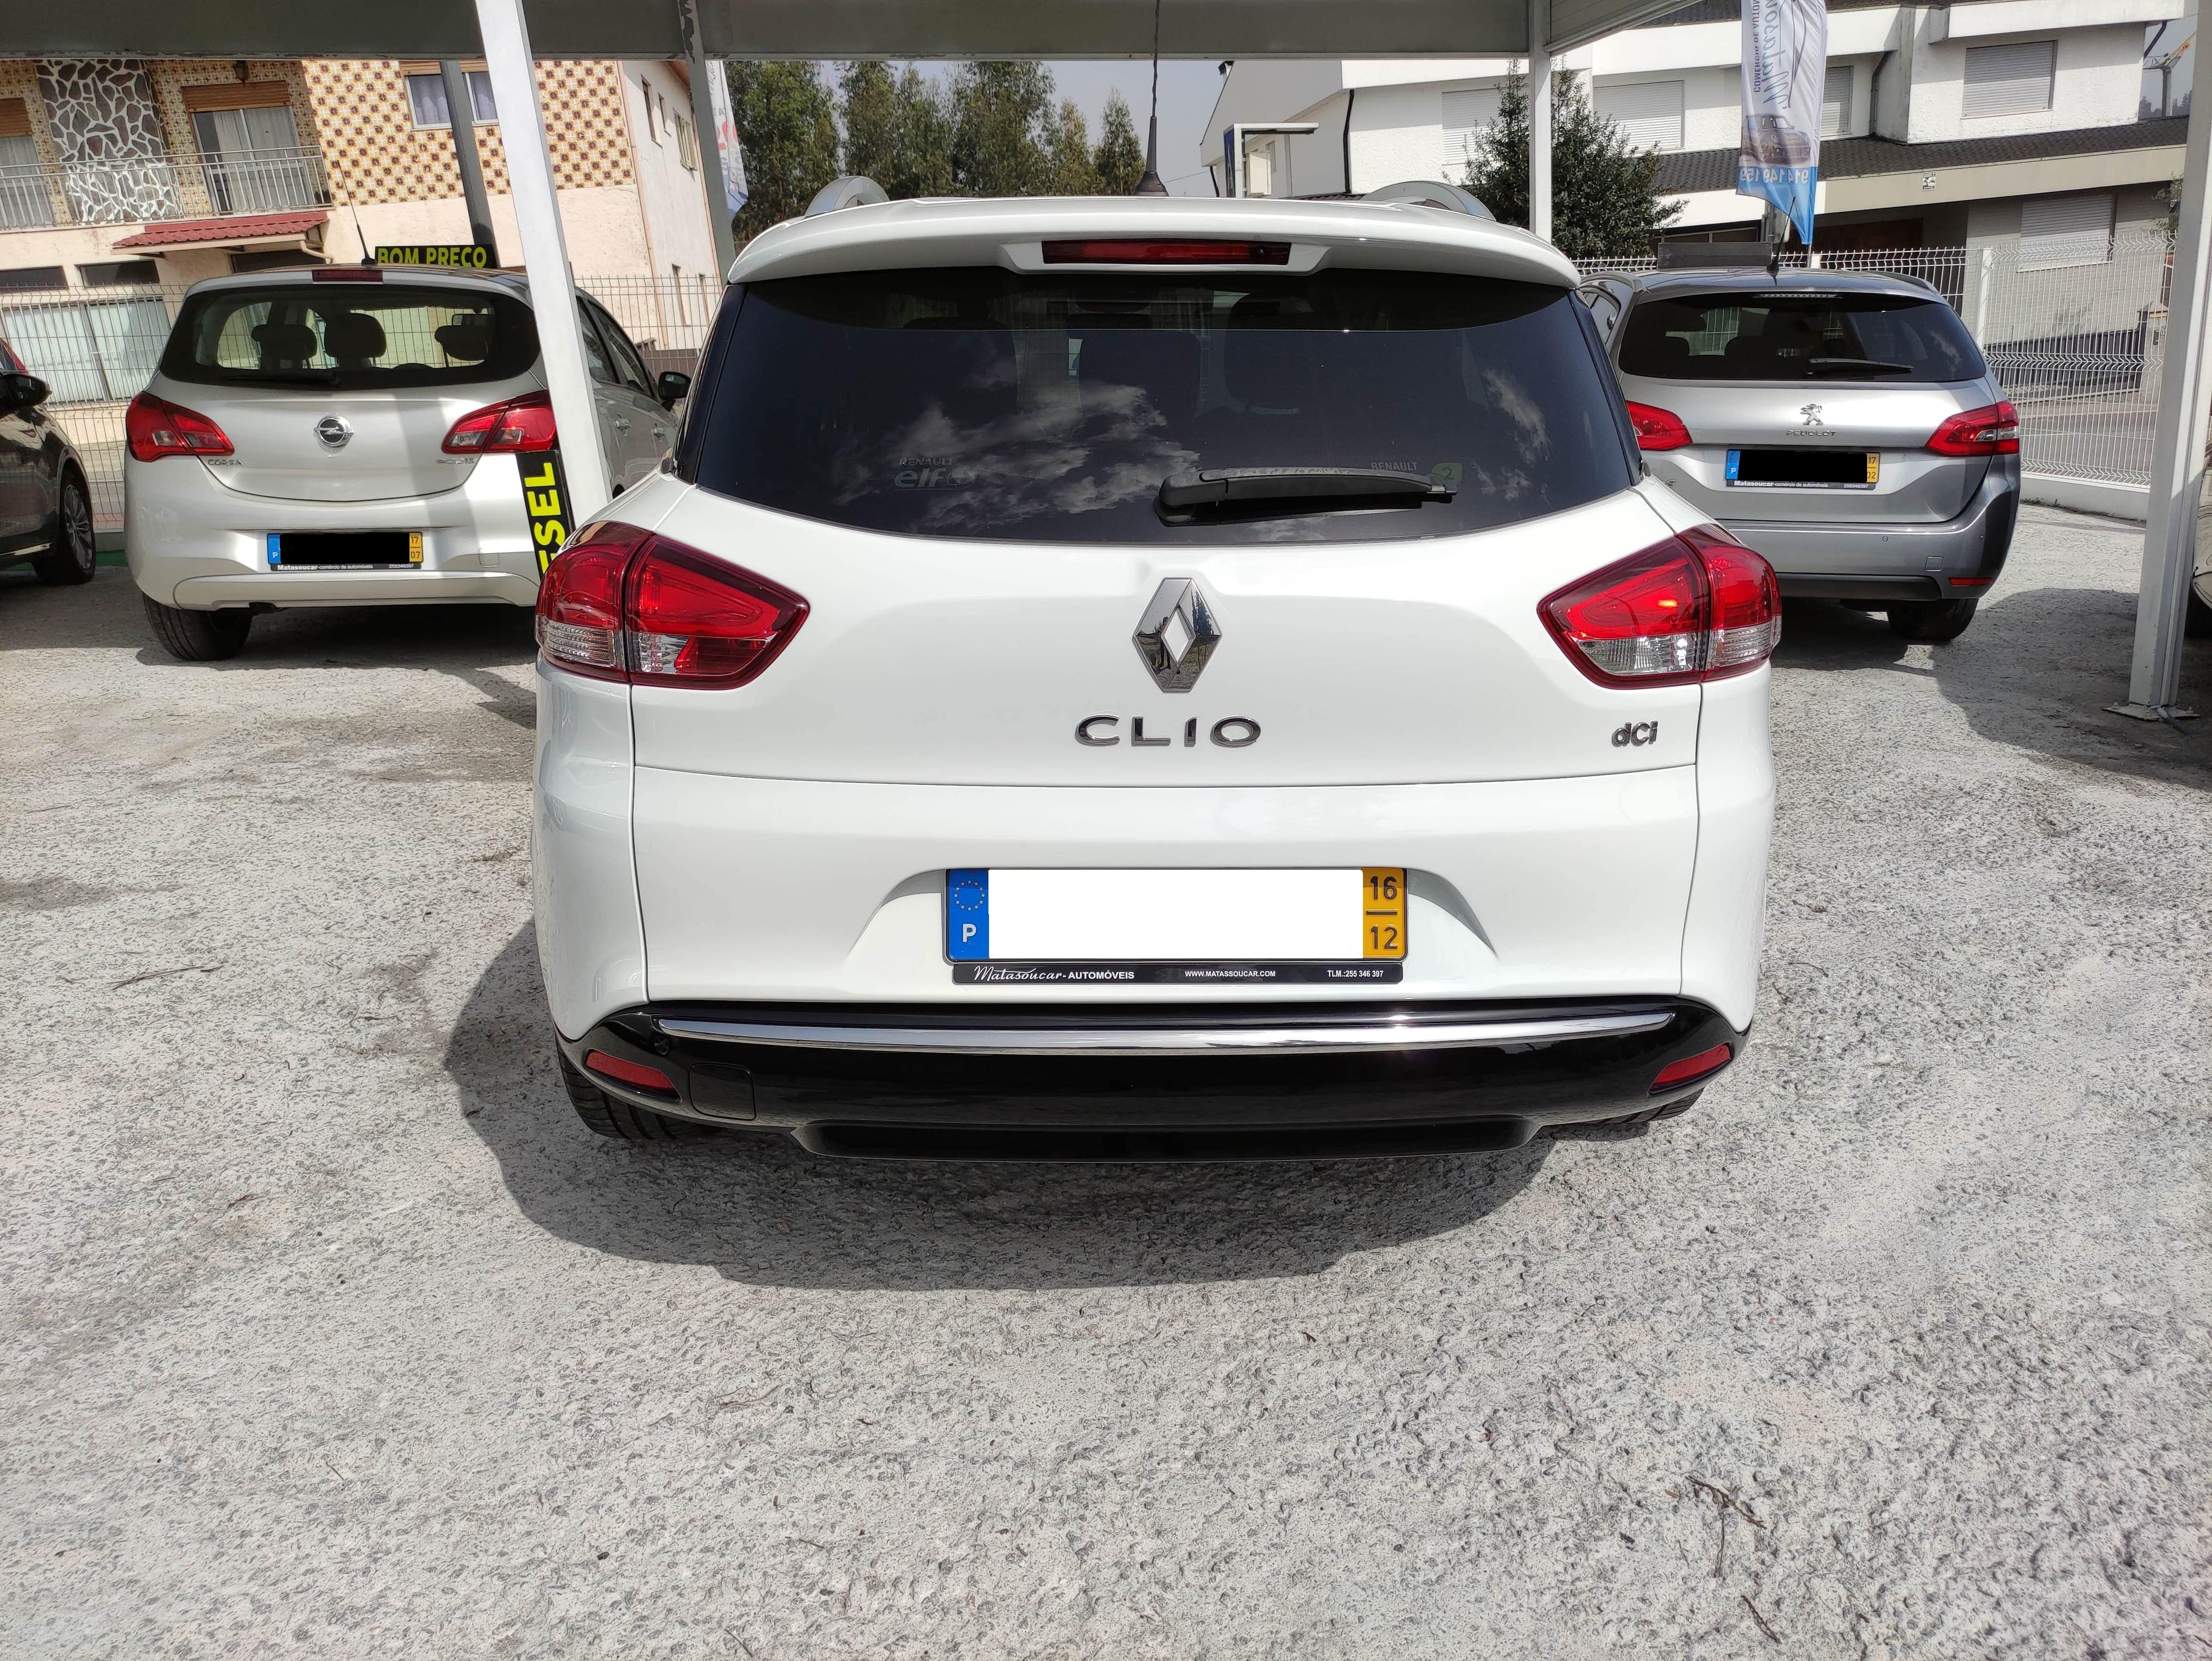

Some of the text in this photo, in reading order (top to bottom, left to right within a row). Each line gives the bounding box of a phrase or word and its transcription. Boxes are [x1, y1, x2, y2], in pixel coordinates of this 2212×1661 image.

[378, 248, 419, 264] BOM
[899, 458, 955, 466] RENAULT
[1371, 461, 1418, 471] RENAULT
[894, 468, 946, 488] elf
[1442, 467, 1454, 480] 2
[411, 536, 419, 545] 17
[411, 551, 420, 559] 07
[1075, 714, 1261, 747] CLIO
[1611, 720, 1658, 747] dCi
[1370, 876, 1397, 900] 16
[962, 923, 977, 943] P
[1371, 926, 1398, 949] 12
[1068, 970, 1135, 980] AUTOMÓVEIS
